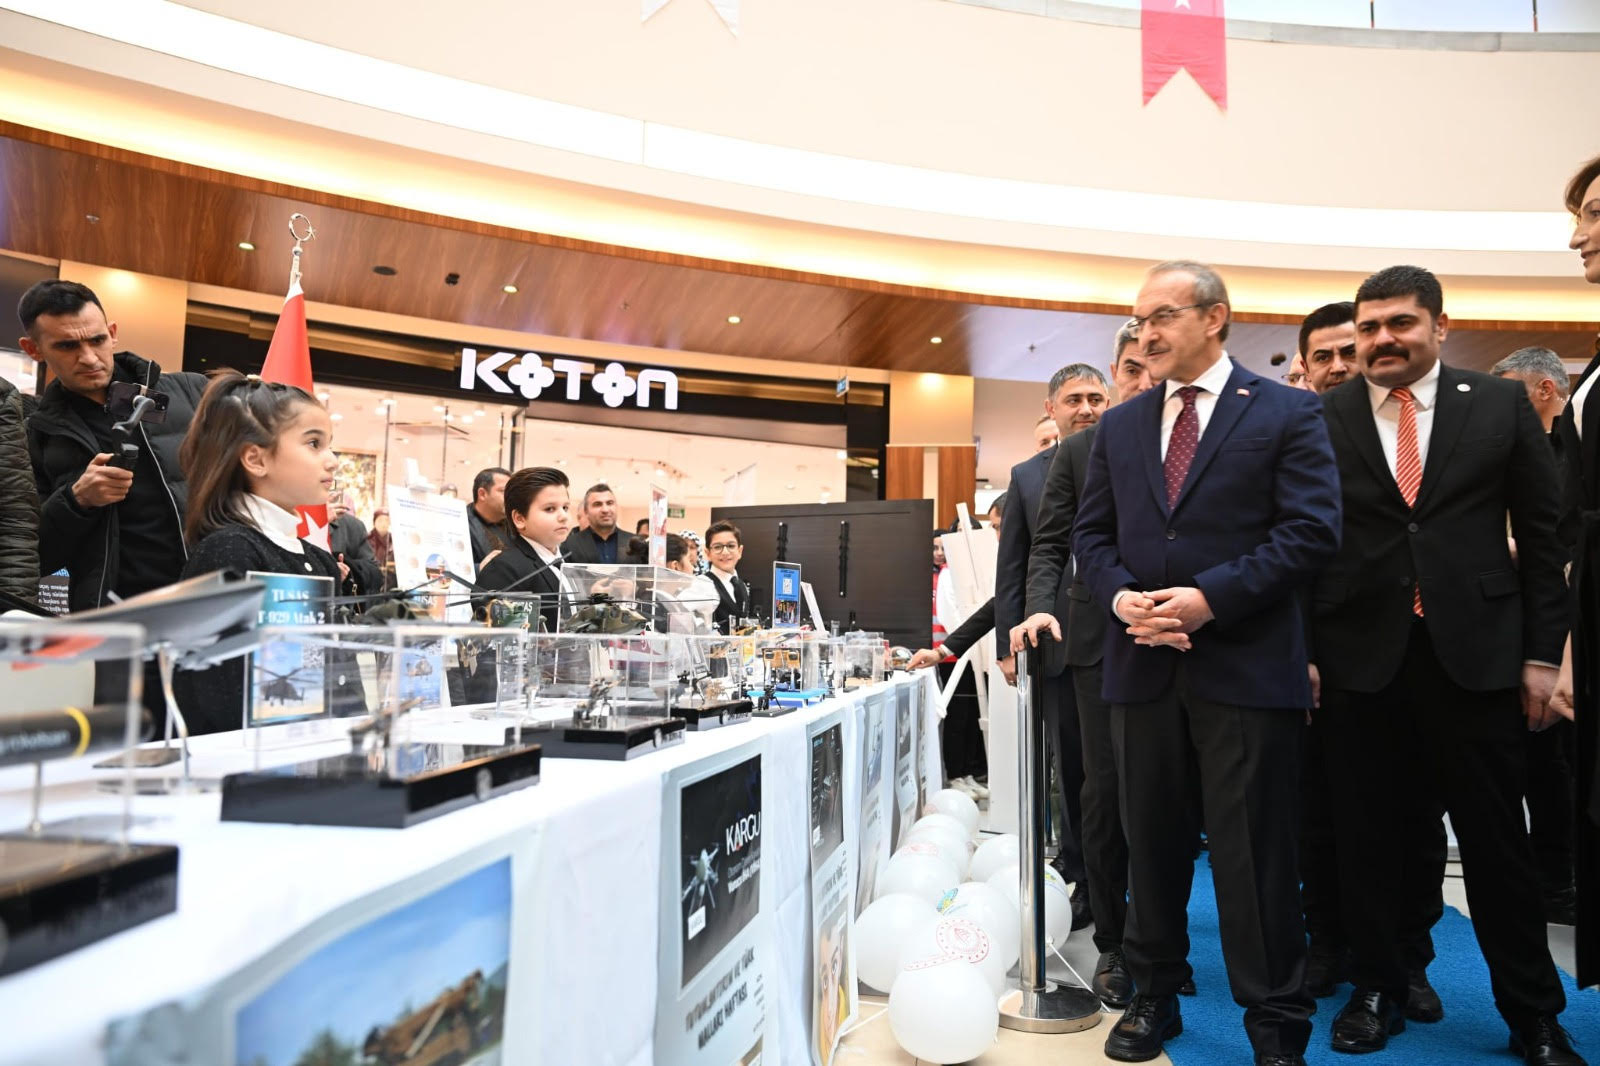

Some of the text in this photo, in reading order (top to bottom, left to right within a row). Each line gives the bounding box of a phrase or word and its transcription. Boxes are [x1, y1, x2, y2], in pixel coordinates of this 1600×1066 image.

[460, 348, 679, 410] KOTON
[318, 612, 326, 624] 2
[726, 811, 761, 856] KARGU
